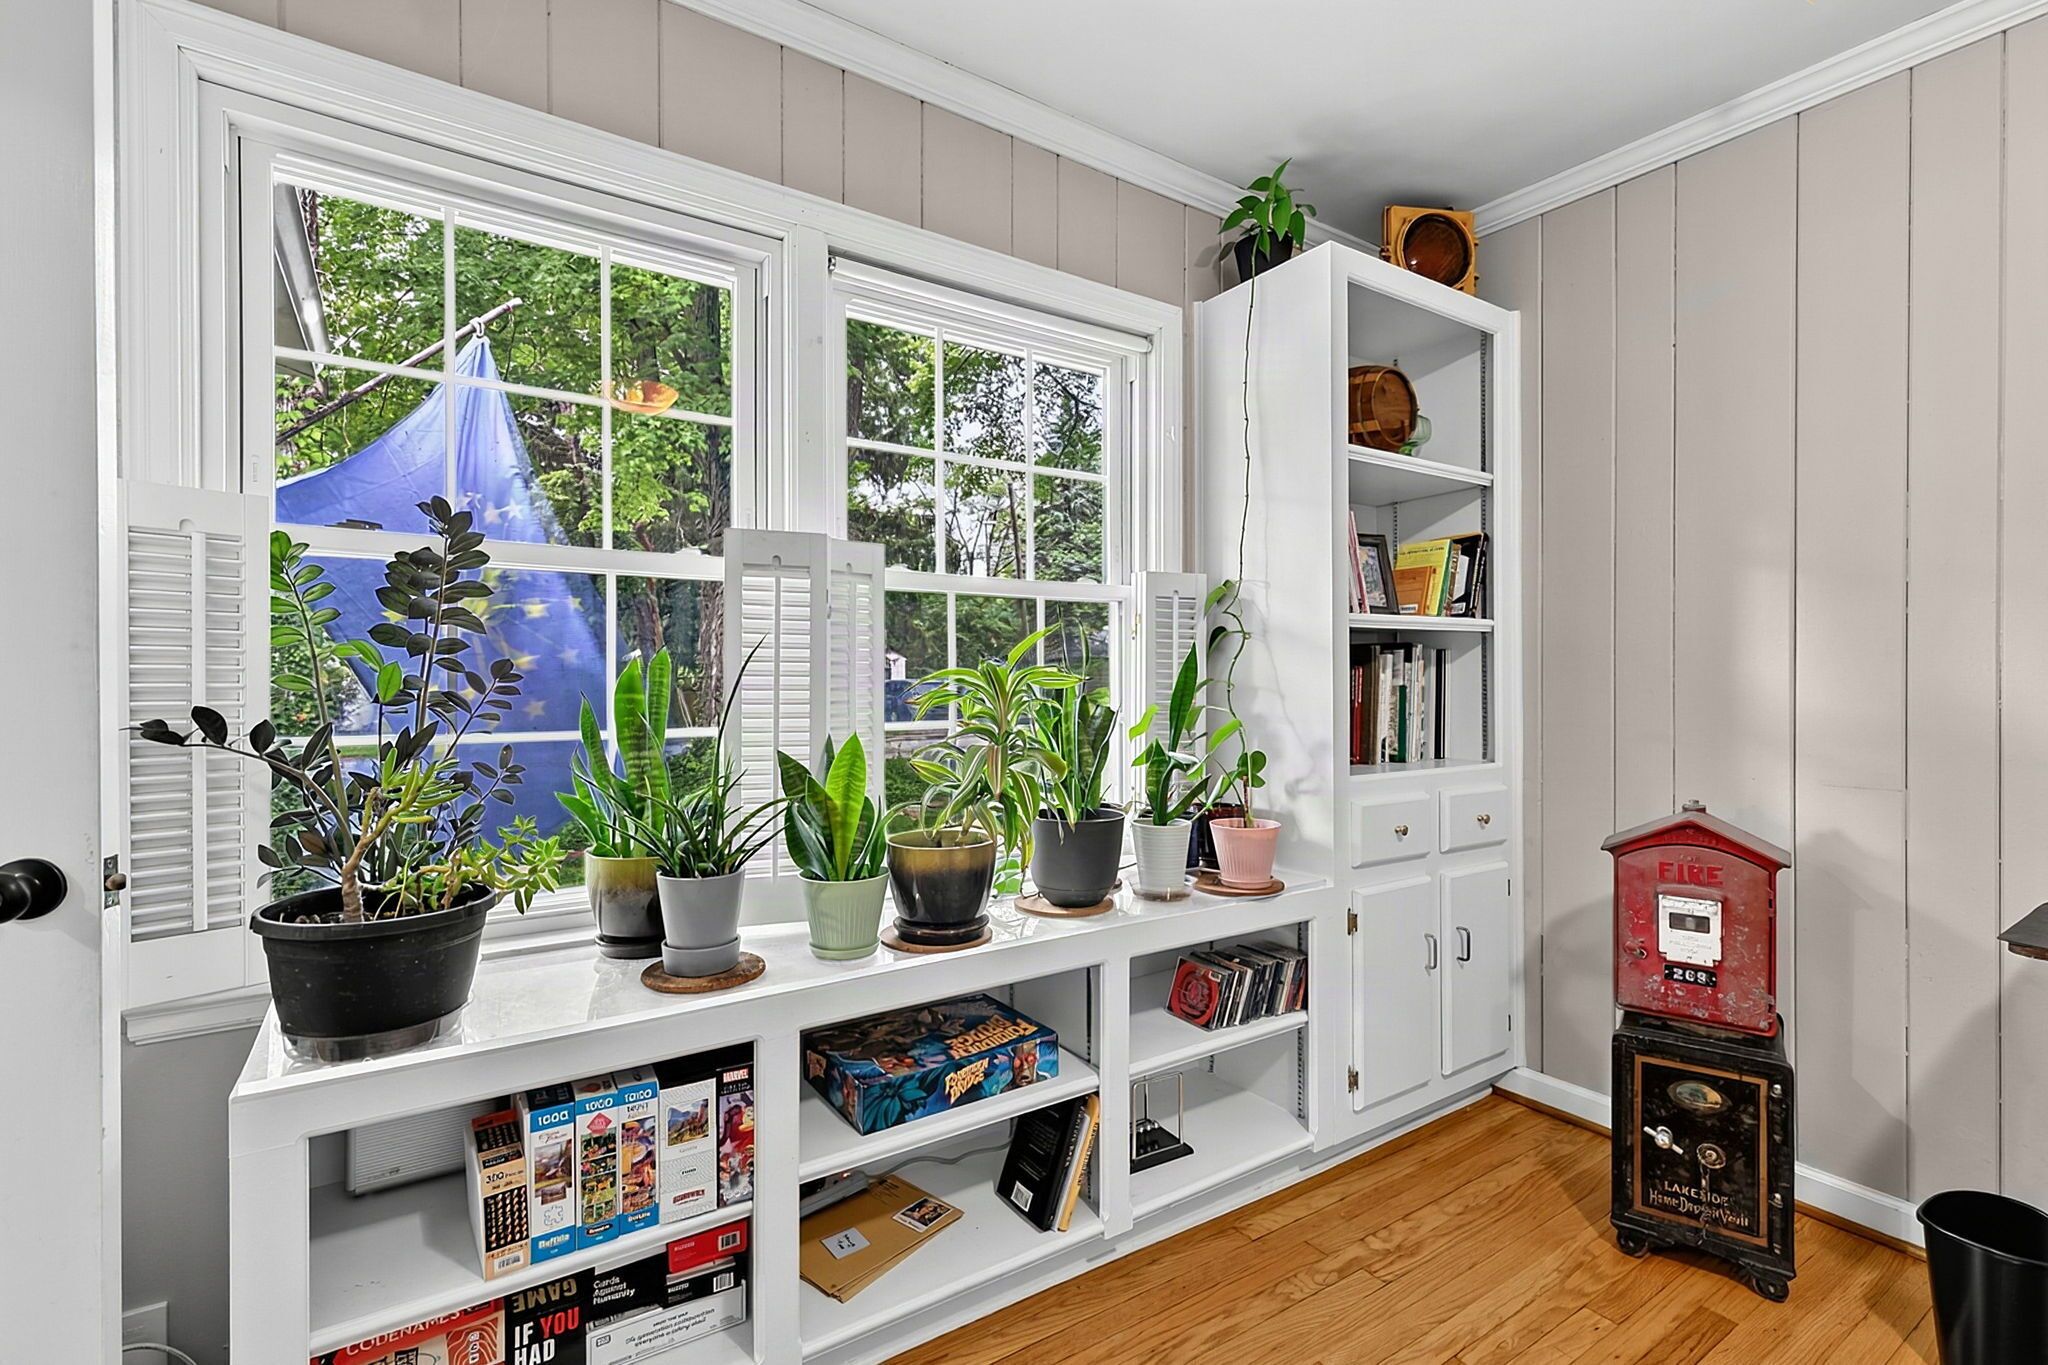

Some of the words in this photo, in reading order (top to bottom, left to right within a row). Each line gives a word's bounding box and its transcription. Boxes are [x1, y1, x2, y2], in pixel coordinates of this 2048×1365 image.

[1658, 861, 1724, 886] FIRE
[723, 1068, 749, 1083] MARVEL
[538, 1110, 569, 1126] 1000
[592, 1276, 621, 1290] Cards
[592, 1282, 627, 1298] Against
[511, 1278, 578, 1313] GAME
[592, 1288, 636, 1305] Humanity
[514, 1321, 534, 1348] IF
[540, 1306, 580, 1339] YOU
[514, 1338, 556, 1365] HAD
